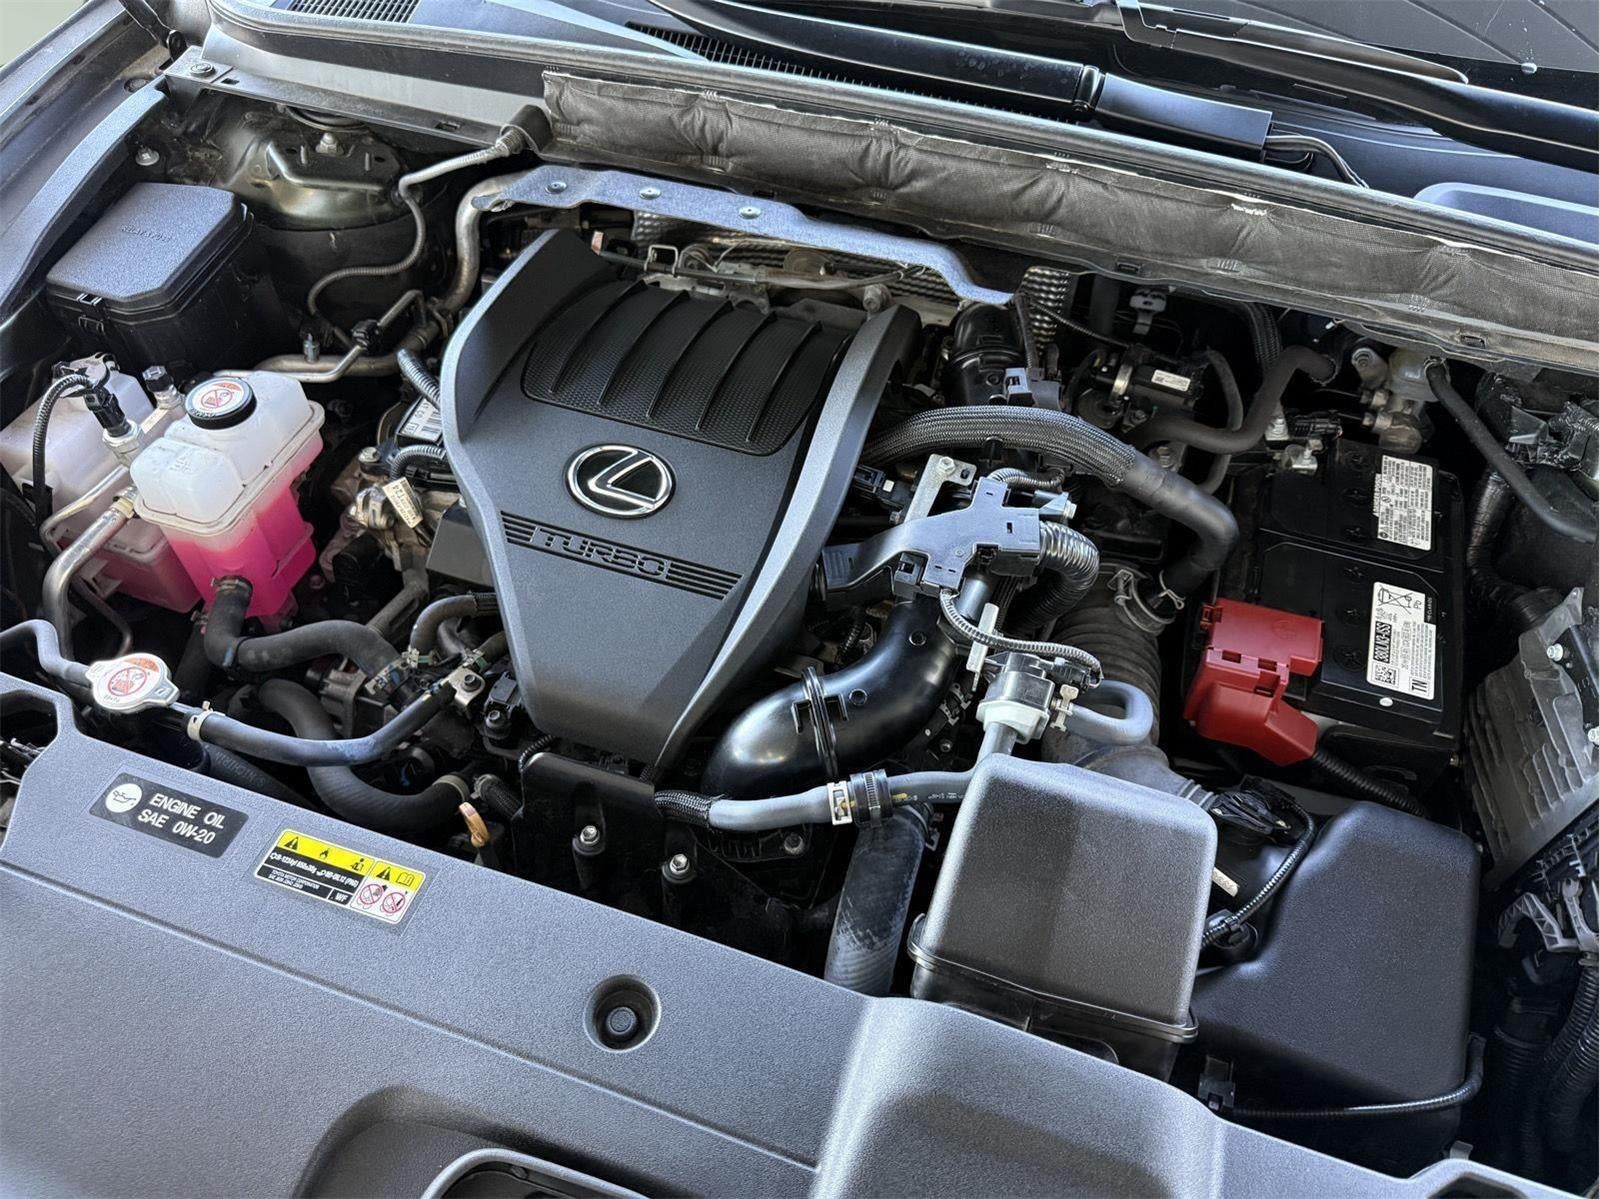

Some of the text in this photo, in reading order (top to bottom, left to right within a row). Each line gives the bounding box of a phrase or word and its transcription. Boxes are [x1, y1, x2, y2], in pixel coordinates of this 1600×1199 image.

[533, 526, 667, 577] TURBO
[1411, 678, 1428, 693] TN
[137, 808, 217, 845] SAE 0W-20
[149, 792, 226, 830] ENGINE OIL
